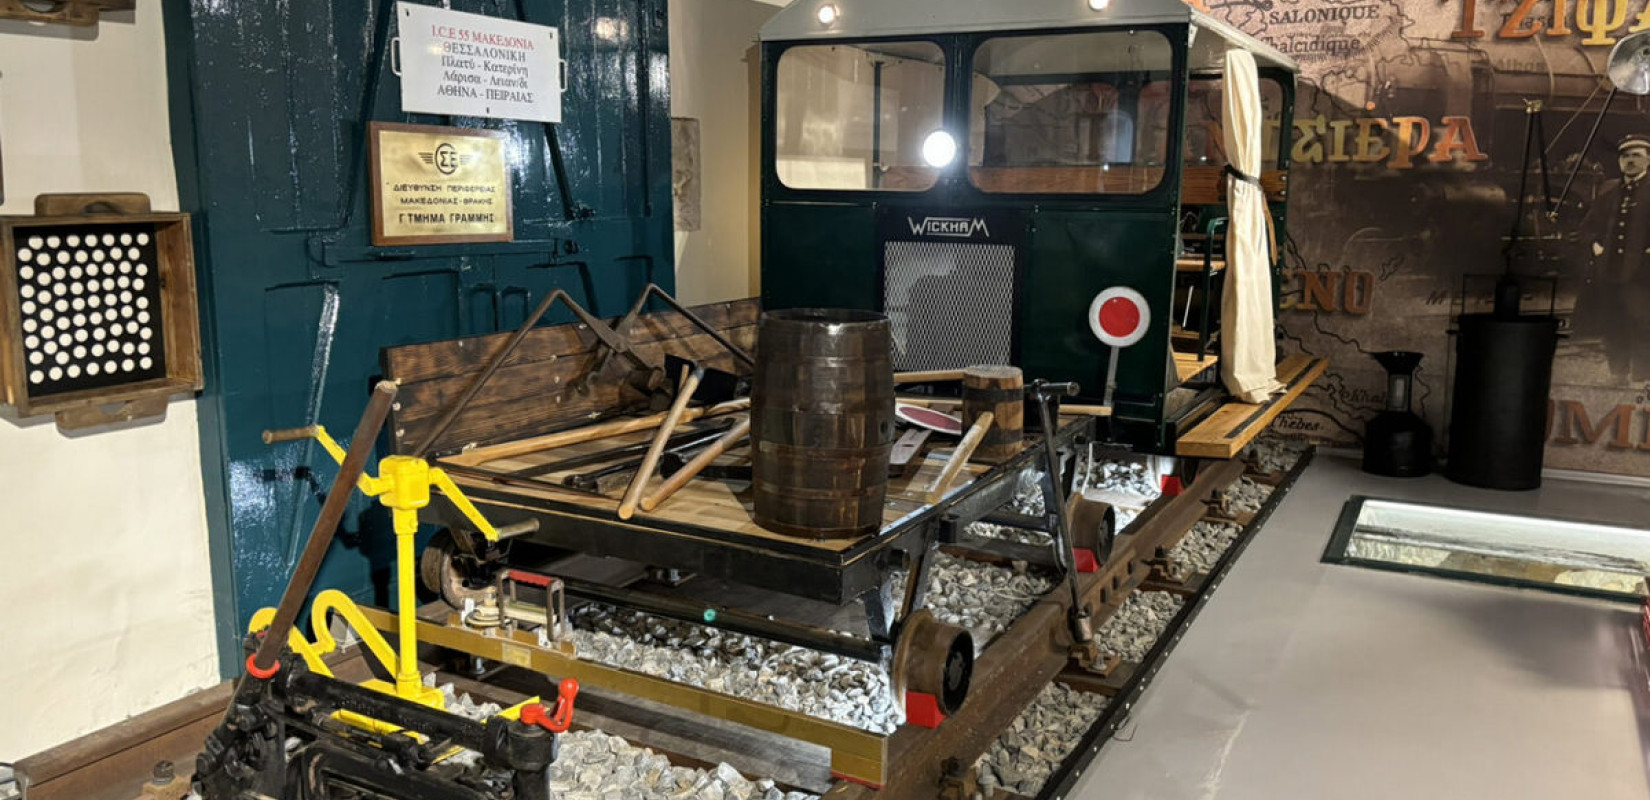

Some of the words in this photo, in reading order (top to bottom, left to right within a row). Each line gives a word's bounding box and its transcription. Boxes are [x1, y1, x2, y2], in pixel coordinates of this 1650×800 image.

[1268, 4, 1380, 26] SALONIQUE
[442, 41, 527, 62] ΘΕΣΣΑΛΟΝΙΚΗ
[441, 55, 475, 70] Πλατύ
[483, 60, 529, 78] Κατερίνη
[443, 69, 482, 85] Λάρισα
[437, 84, 478, 98] ΑΘΗΝΑ
[486, 88, 534, 103] ΠΕΙΡΑΙΑΣ
[393, 183, 442, 192] ΔΙΕΥΘΥΝΣΗ
[407, 212, 445, 224] ΤΜΗΜΑ
[449, 212, 495, 223] ΓΡΑΜΜΗΣ
[907, 215, 990, 237] WICKHAM
